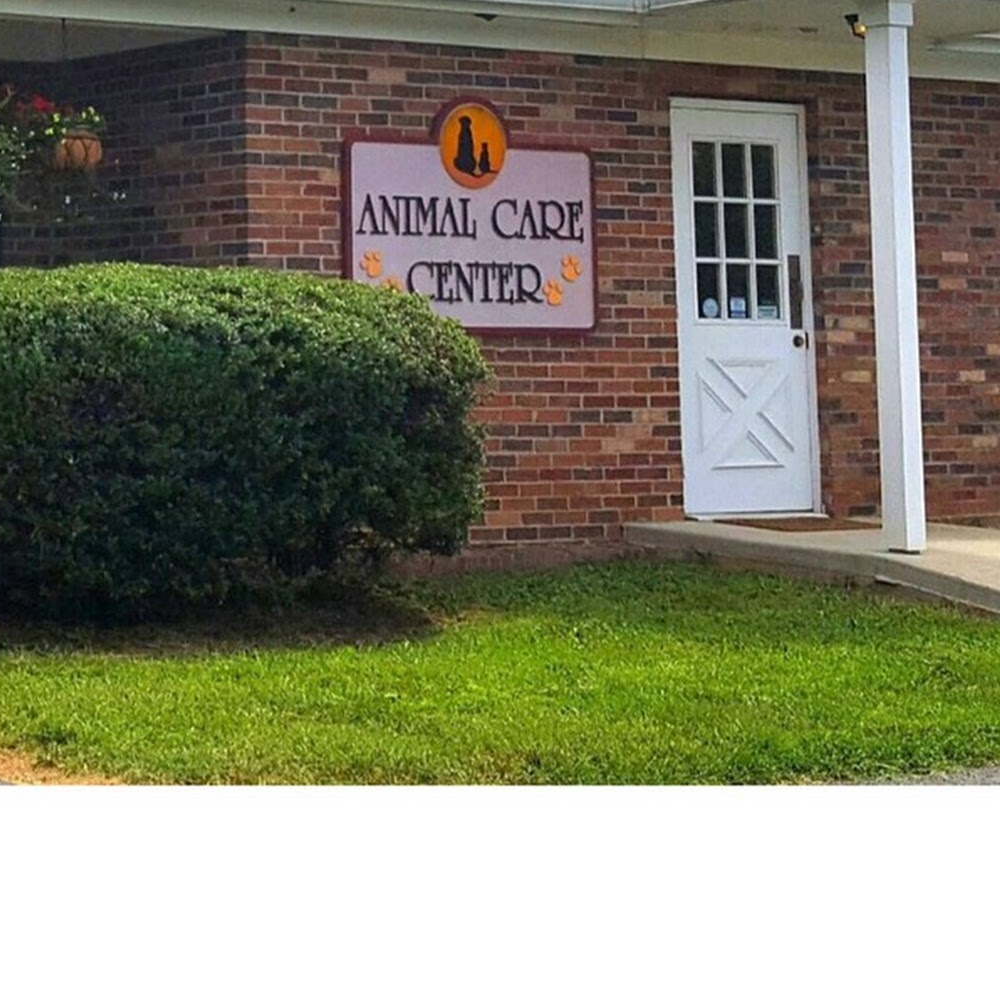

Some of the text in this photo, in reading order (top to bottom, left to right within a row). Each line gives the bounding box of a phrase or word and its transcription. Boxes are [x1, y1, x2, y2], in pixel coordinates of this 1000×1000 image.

[355, 193, 584, 243] ANIMAL CARE
[406, 260, 544, 306] CENTER
